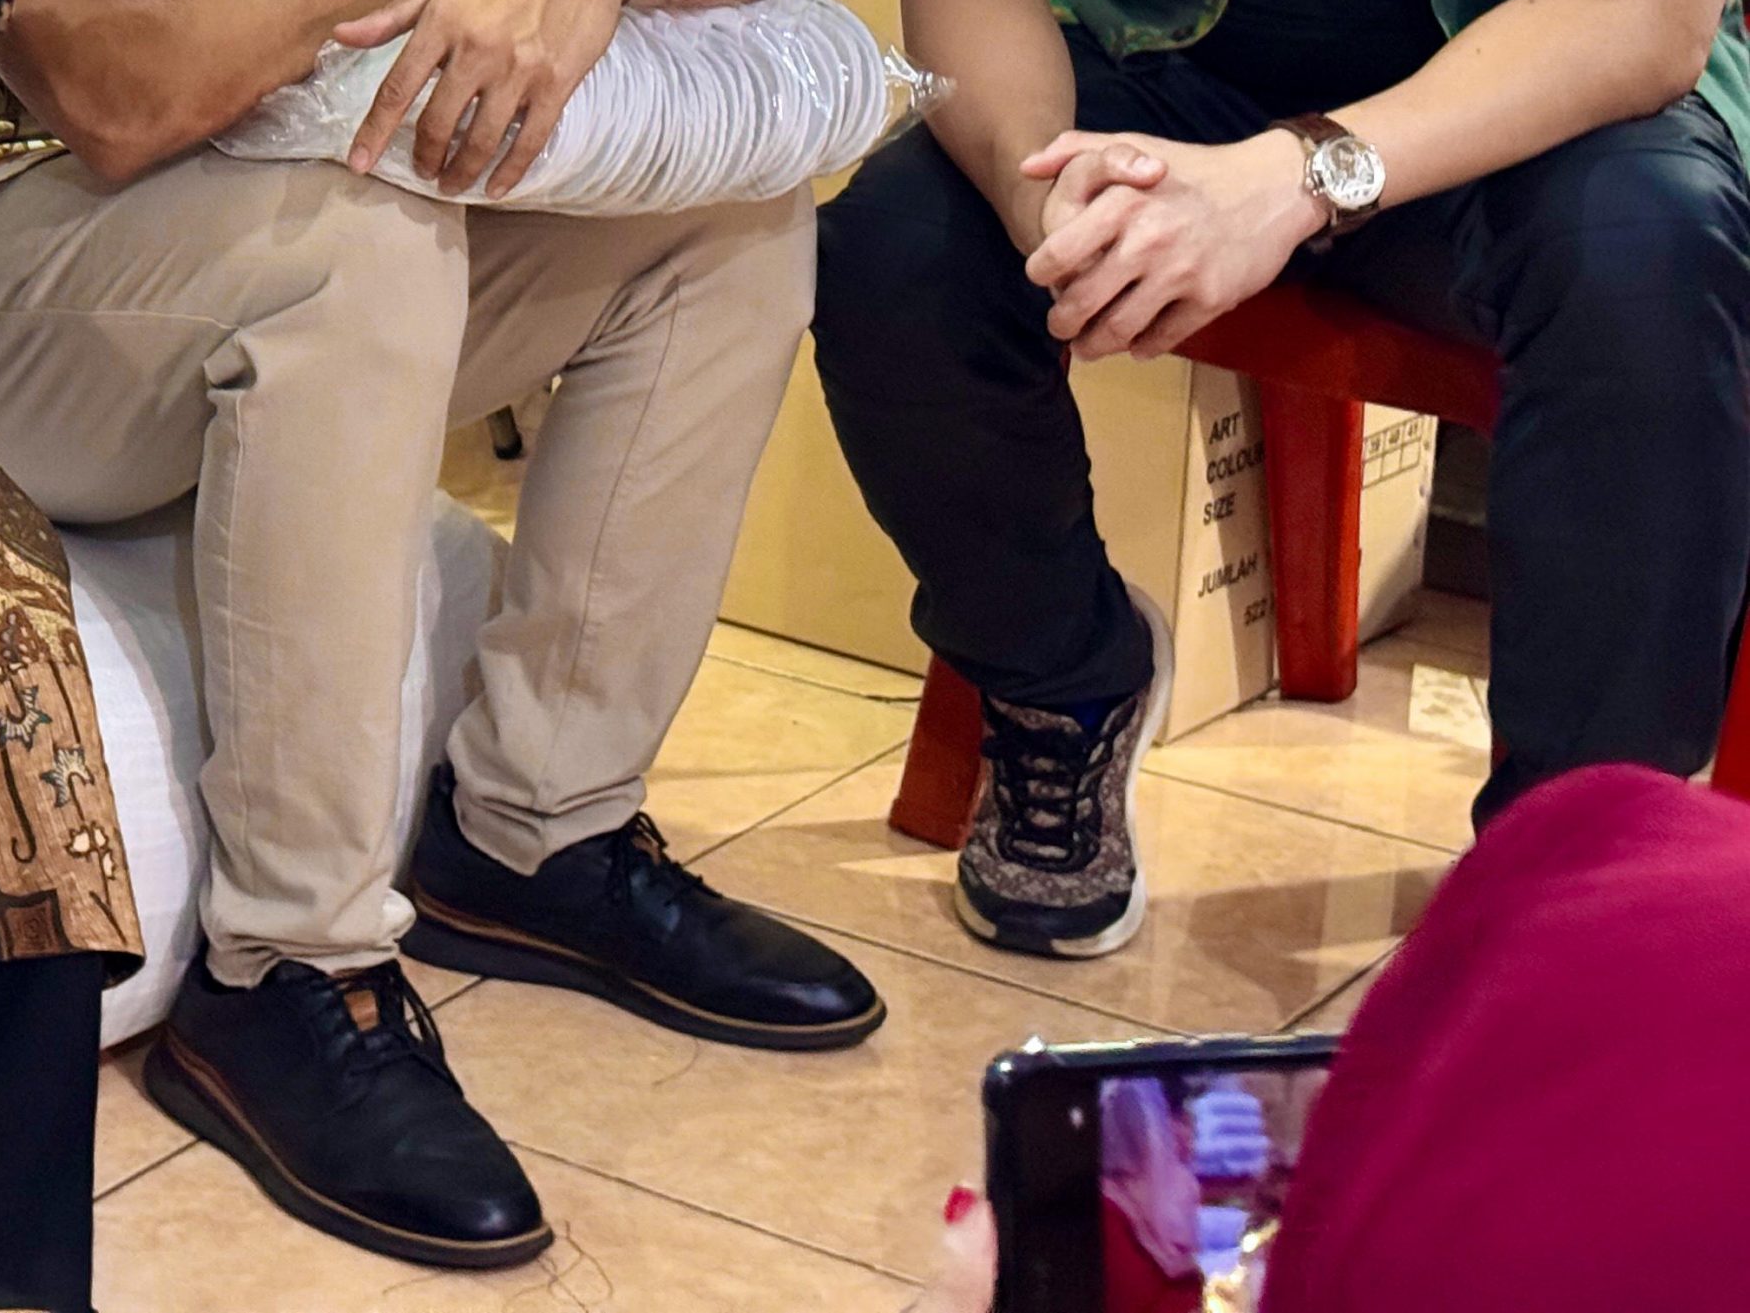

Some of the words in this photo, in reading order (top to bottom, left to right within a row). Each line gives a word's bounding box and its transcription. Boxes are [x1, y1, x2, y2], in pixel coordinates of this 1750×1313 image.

[1208, 411, 1241, 445] ART
[1203, 491, 1236, 526] SIZE
[1198, 552, 1259, 598] JUMLAH
